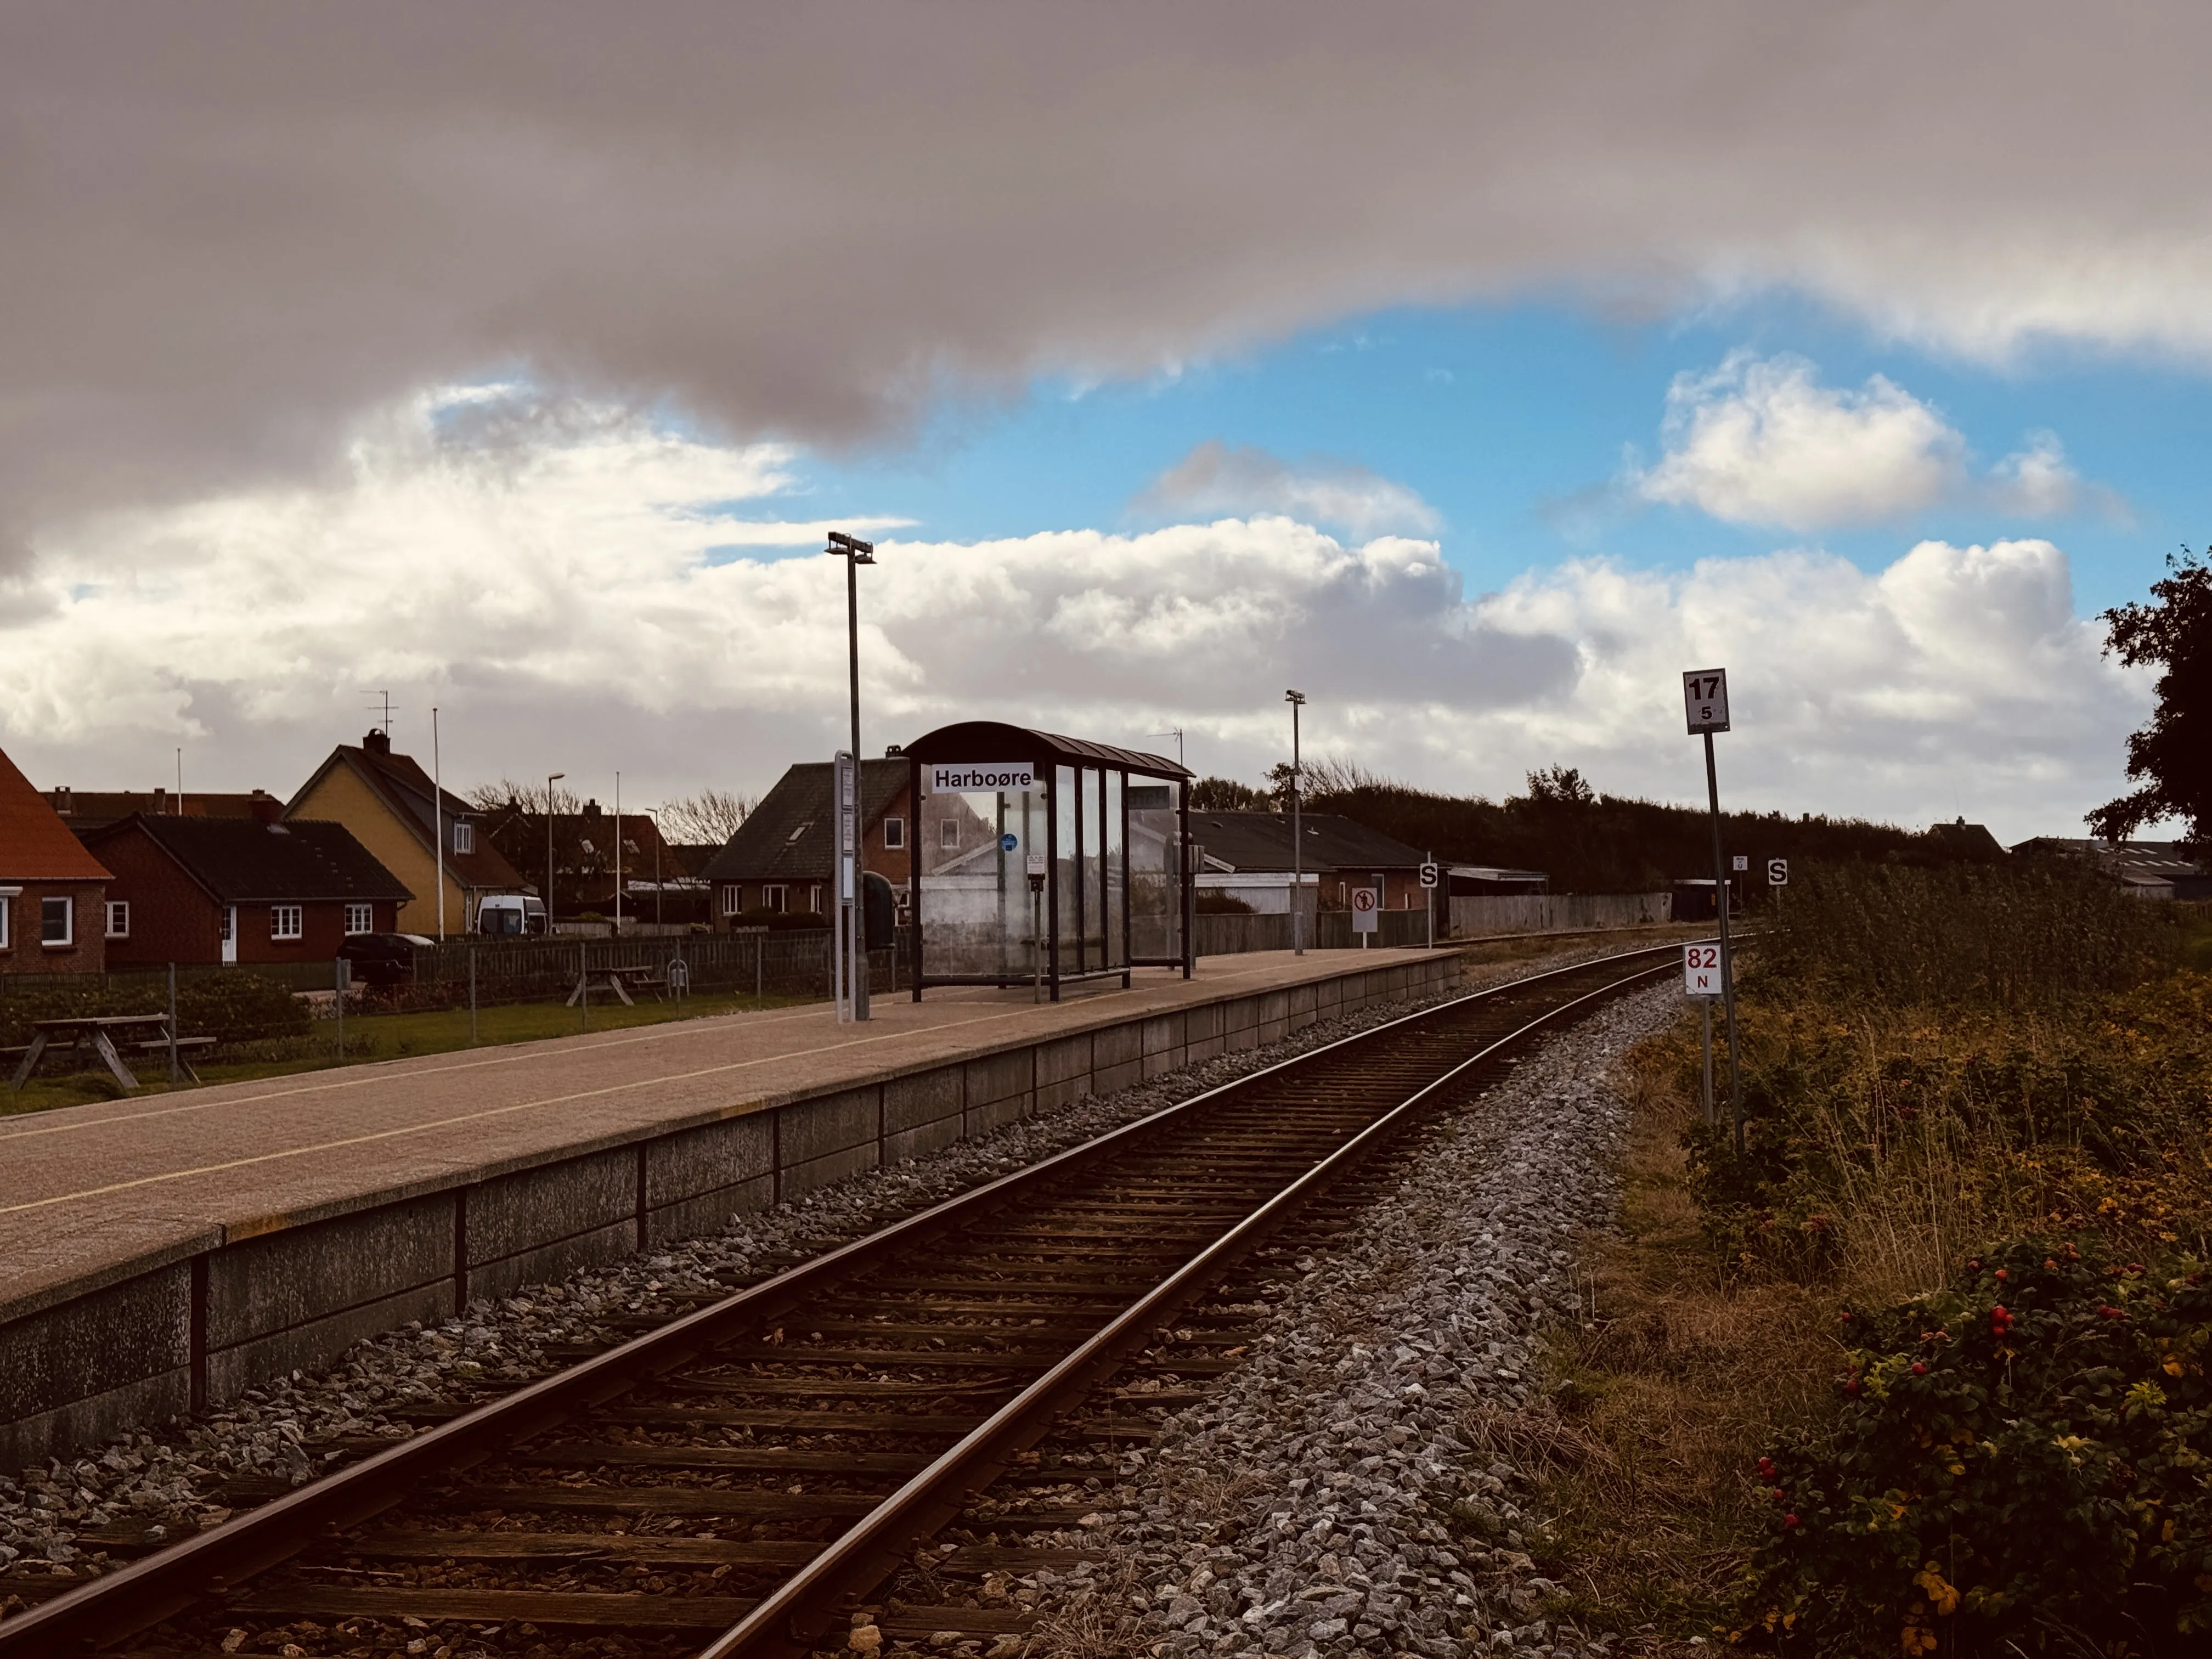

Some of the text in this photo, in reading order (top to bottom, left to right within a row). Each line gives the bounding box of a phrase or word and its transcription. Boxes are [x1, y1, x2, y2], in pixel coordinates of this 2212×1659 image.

[1689, 676, 1719, 701] 17
[1701, 706, 1712, 720] 5
[936, 769, 1031, 787] Harboøre
[1421, 865, 1437, 885] S
[1769, 862, 1786, 882] S
[1688, 948, 1717, 969] 82
[1697, 975, 1708, 988] N
